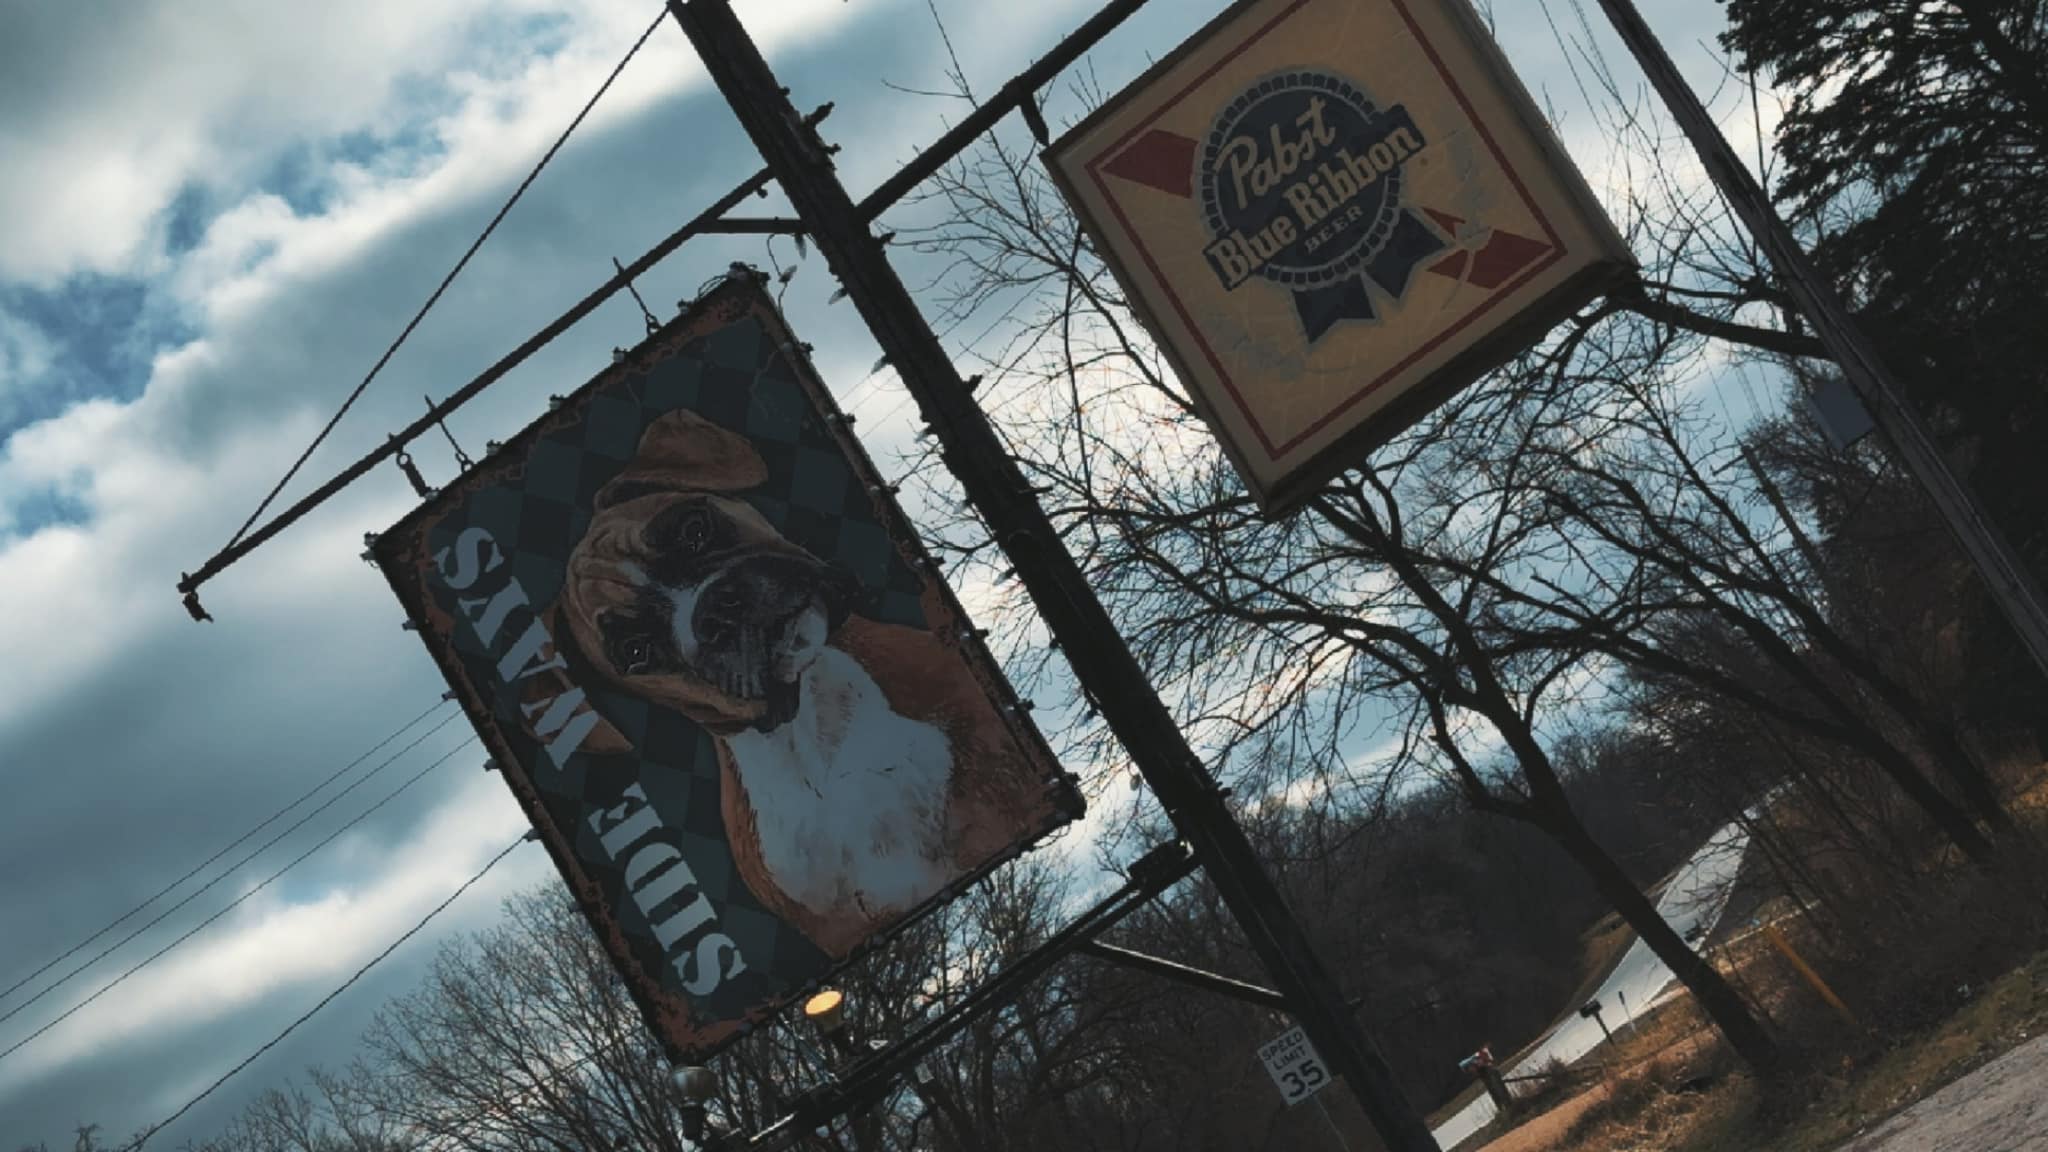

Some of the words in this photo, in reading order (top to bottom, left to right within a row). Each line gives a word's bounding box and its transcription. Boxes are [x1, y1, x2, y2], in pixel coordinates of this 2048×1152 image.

[1212, 96, 1336, 210] Pabst
[1205, 216, 1297, 285] Blue
[1283, 127, 1422, 231] Ribbon
[1303, 205, 1364, 253] BEER
[433, 527, 598, 771] WAYS
[588, 782, 747, 996] SIDE
[1262, 1031, 1303, 1061] SPEED
[1273, 1045, 1306, 1070] LIMIT
[1281, 1059, 1325, 1098] 35
